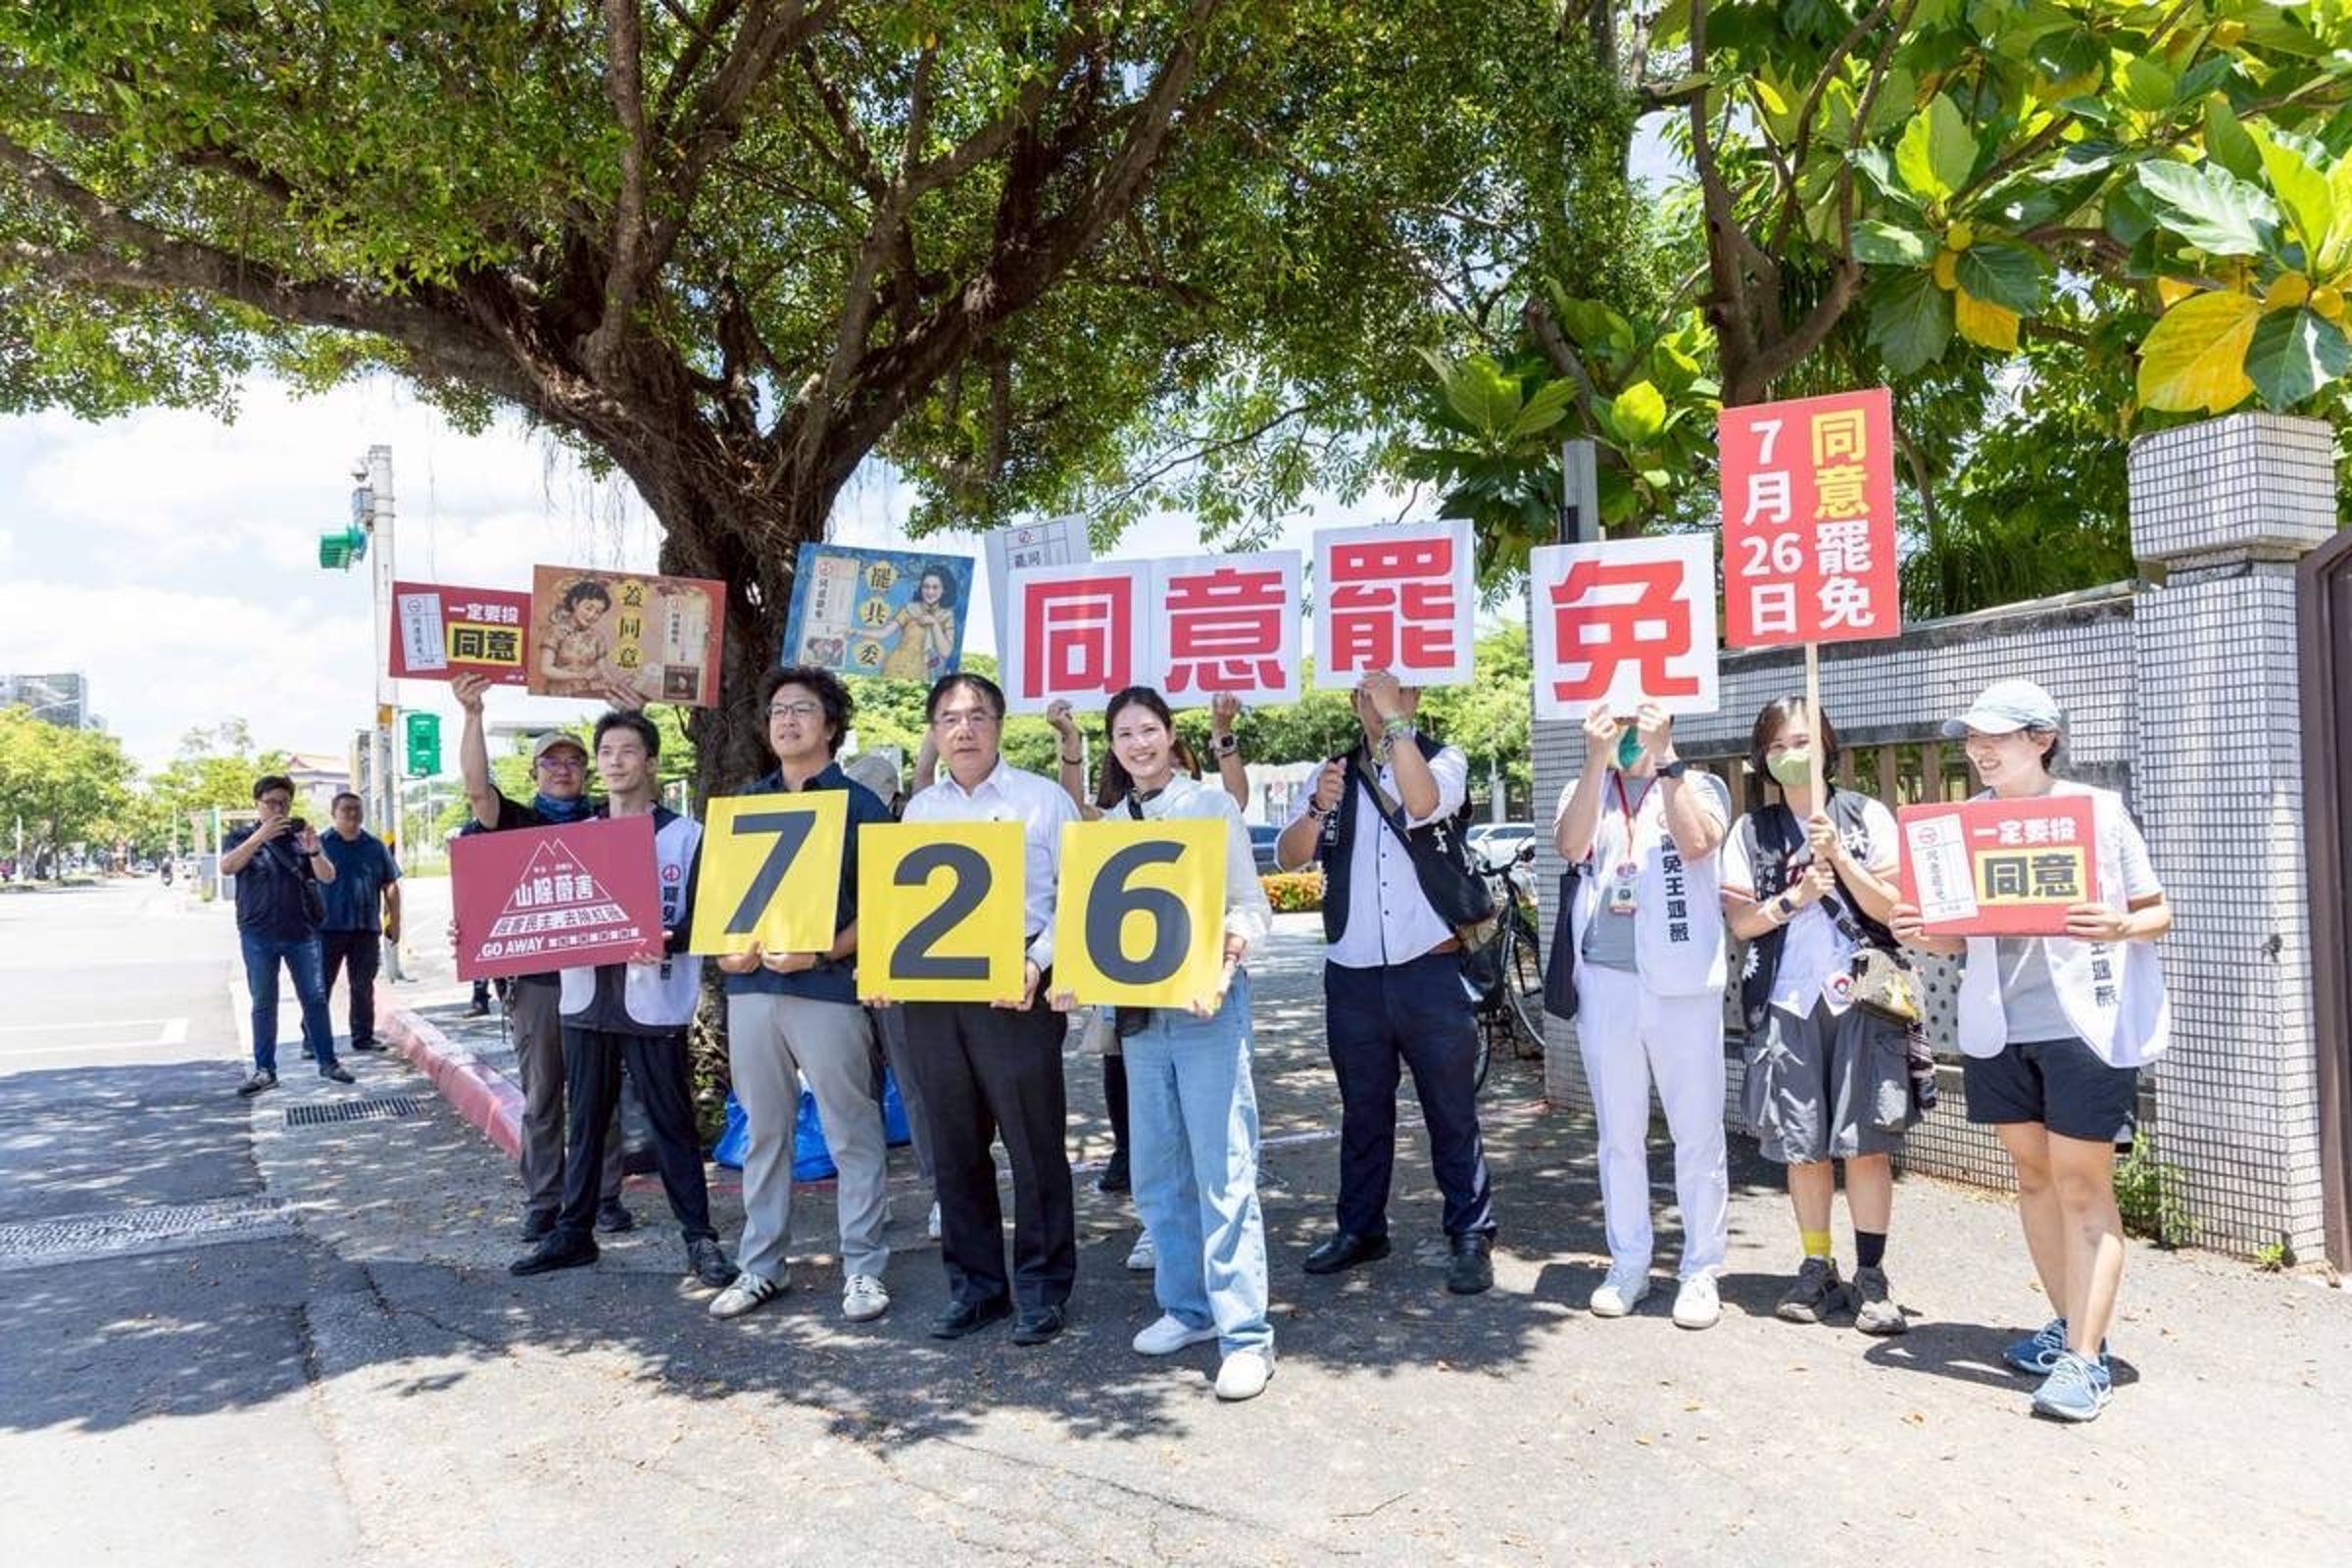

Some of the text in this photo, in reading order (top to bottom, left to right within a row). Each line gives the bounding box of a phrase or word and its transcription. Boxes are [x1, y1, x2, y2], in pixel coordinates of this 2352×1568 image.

[1740, 417, 1803, 637] 7月26日
[1810, 408, 1876, 629] 同意罷免
[452, 626, 518, 662] 同意
[1024, 538, 1700, 703] 同 意 罷 免
[1974, 816, 2077, 844] 一定要投
[1984, 855, 2079, 899] 同意
[481, 941, 503, 957] GO
[505, 936, 545, 956] AWAY
[723, 809, 1192, 986] 7 2 6
